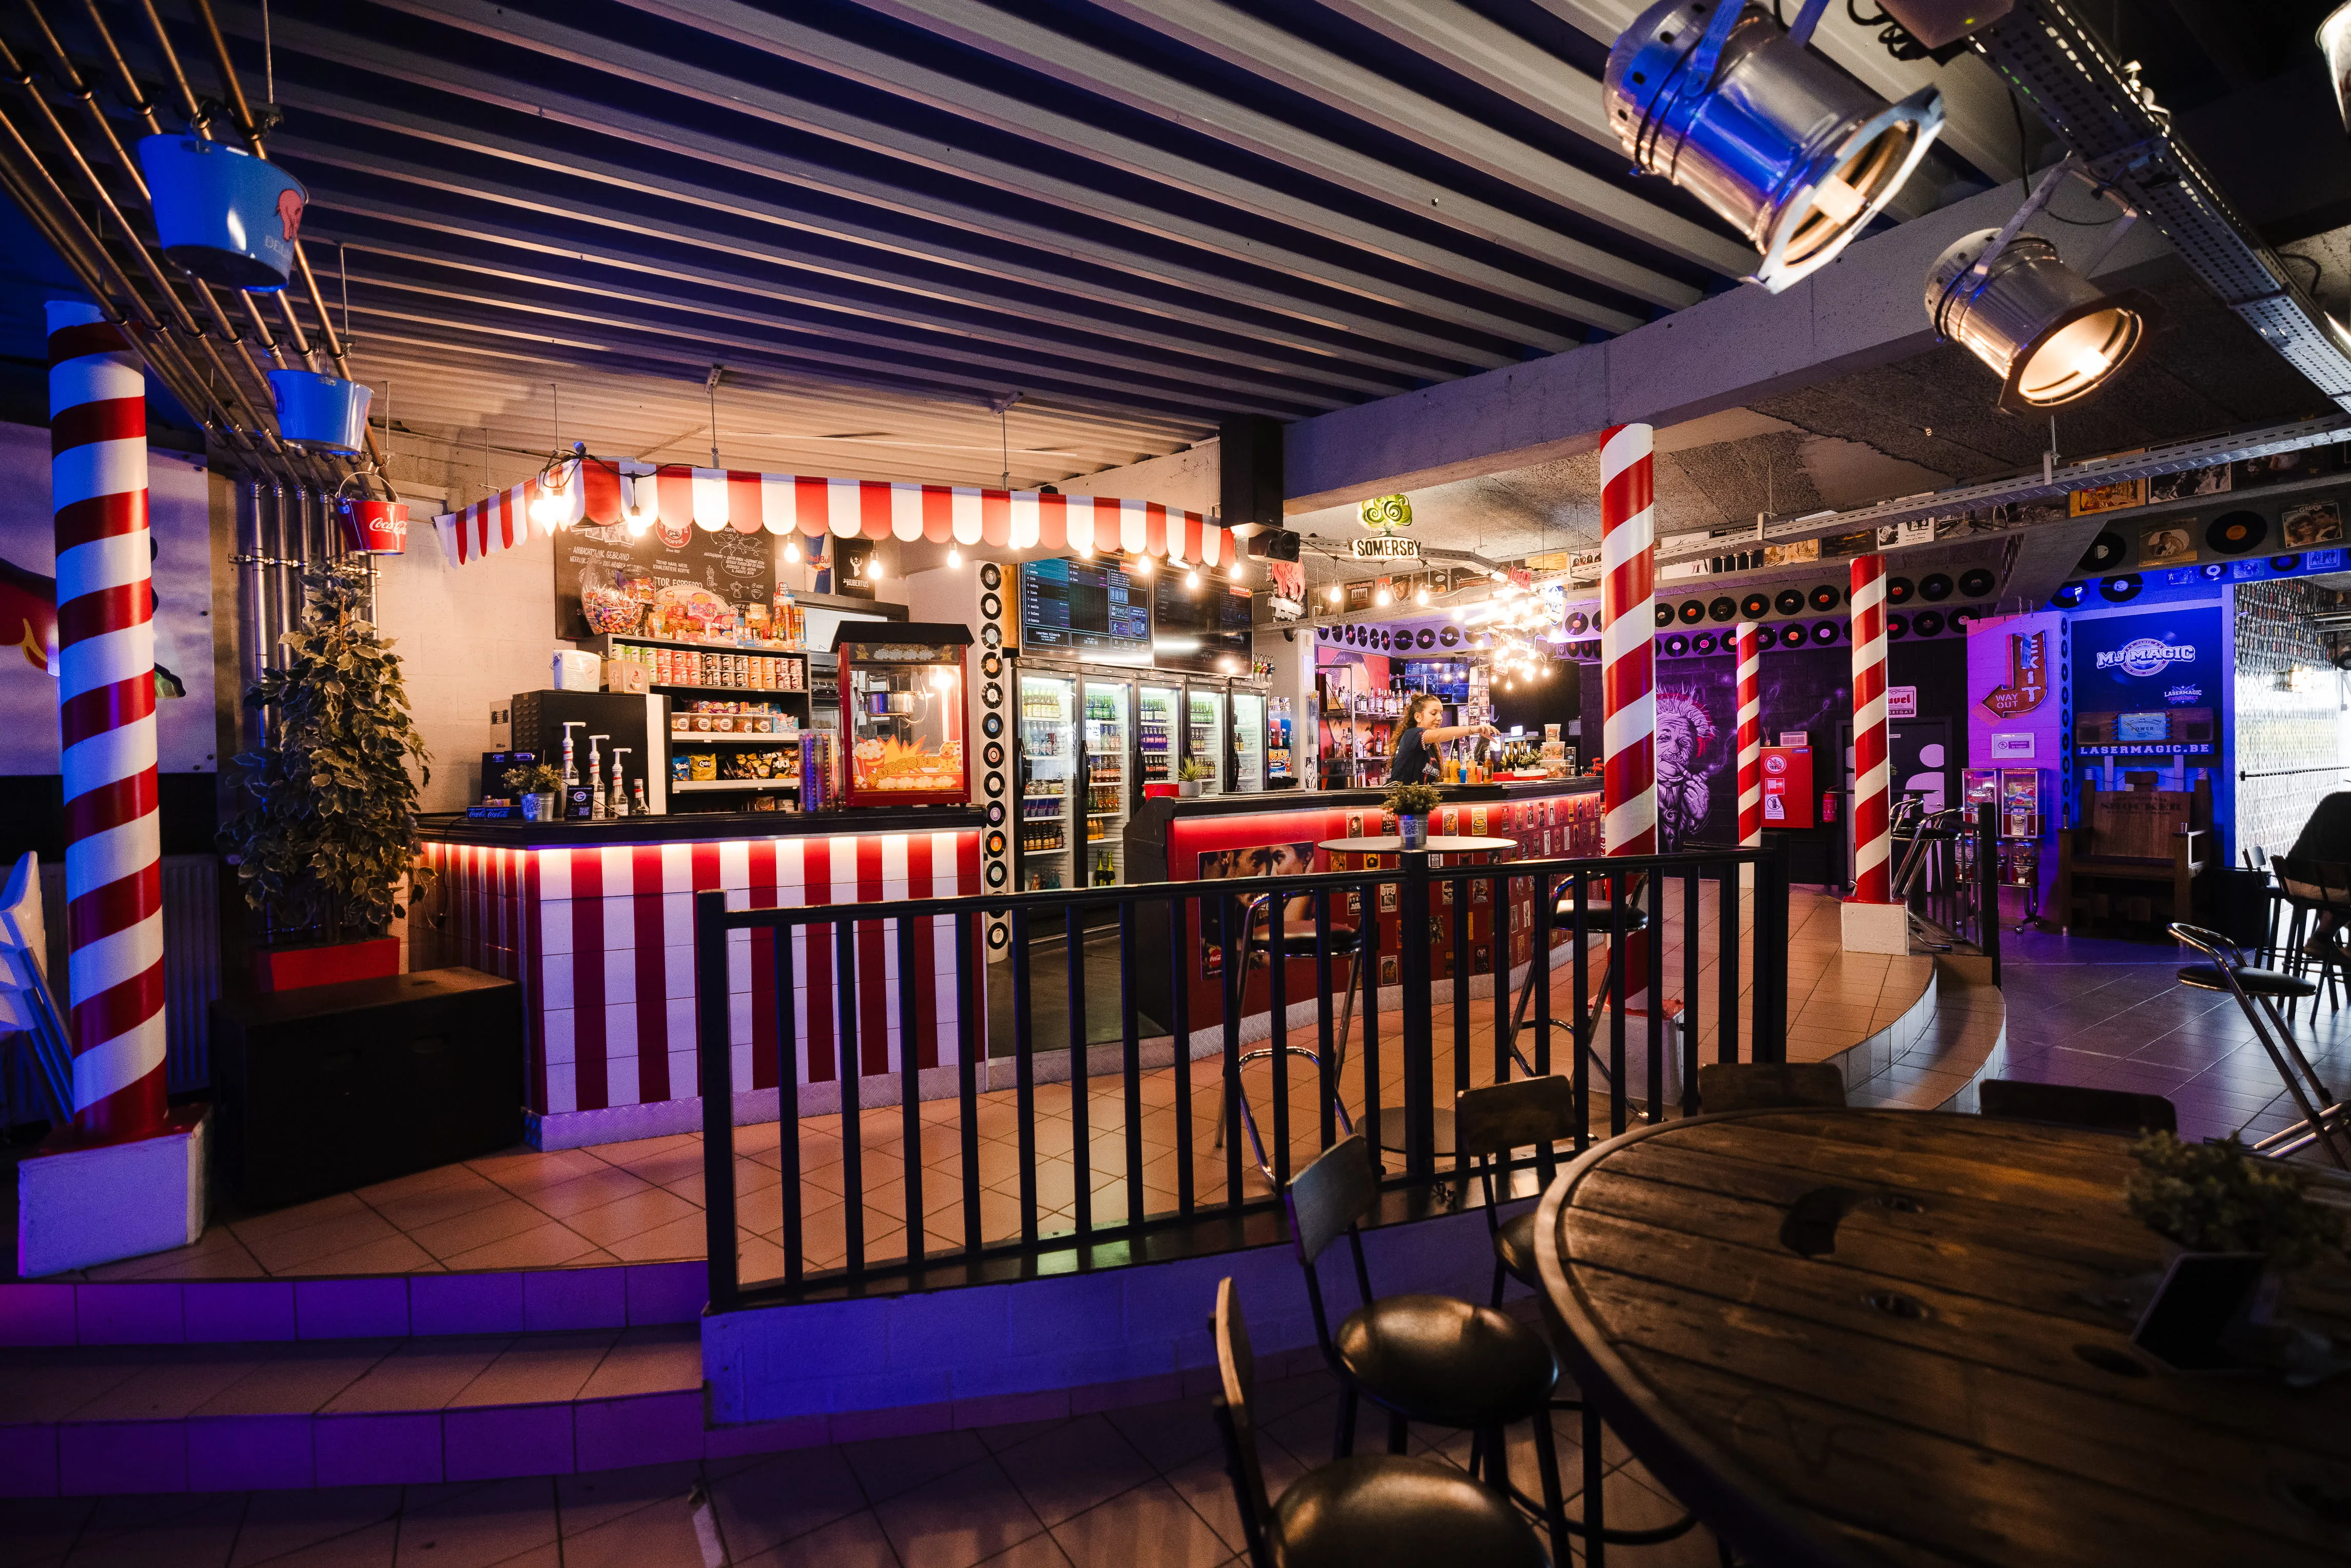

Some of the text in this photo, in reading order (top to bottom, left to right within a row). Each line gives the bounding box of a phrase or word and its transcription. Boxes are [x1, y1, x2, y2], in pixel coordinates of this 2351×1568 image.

[2299, 505, 2322, 513] GREASE
[665, 536, 684, 545] KOFFIE
[1357, 540, 1422, 556] SOMERSBY
[606, 551, 630, 561] GEBRAND
[821, 555, 830, 564] Bull
[653, 564, 677, 572] KWALITATIEVE
[847, 578, 869, 588] HUBERTUS
[2096, 645, 2195, 669] MJ MAGIC
[1889, 694, 1911, 704] uvel
[1995, 693, 2018, 702] WAY
[1996, 701, 2018, 709] OUT
[2080, 744, 2209, 754] LASERMAGIC.BE
[865, 756, 940, 787] POPCORN
[1381, 888, 1396, 896] UFO
